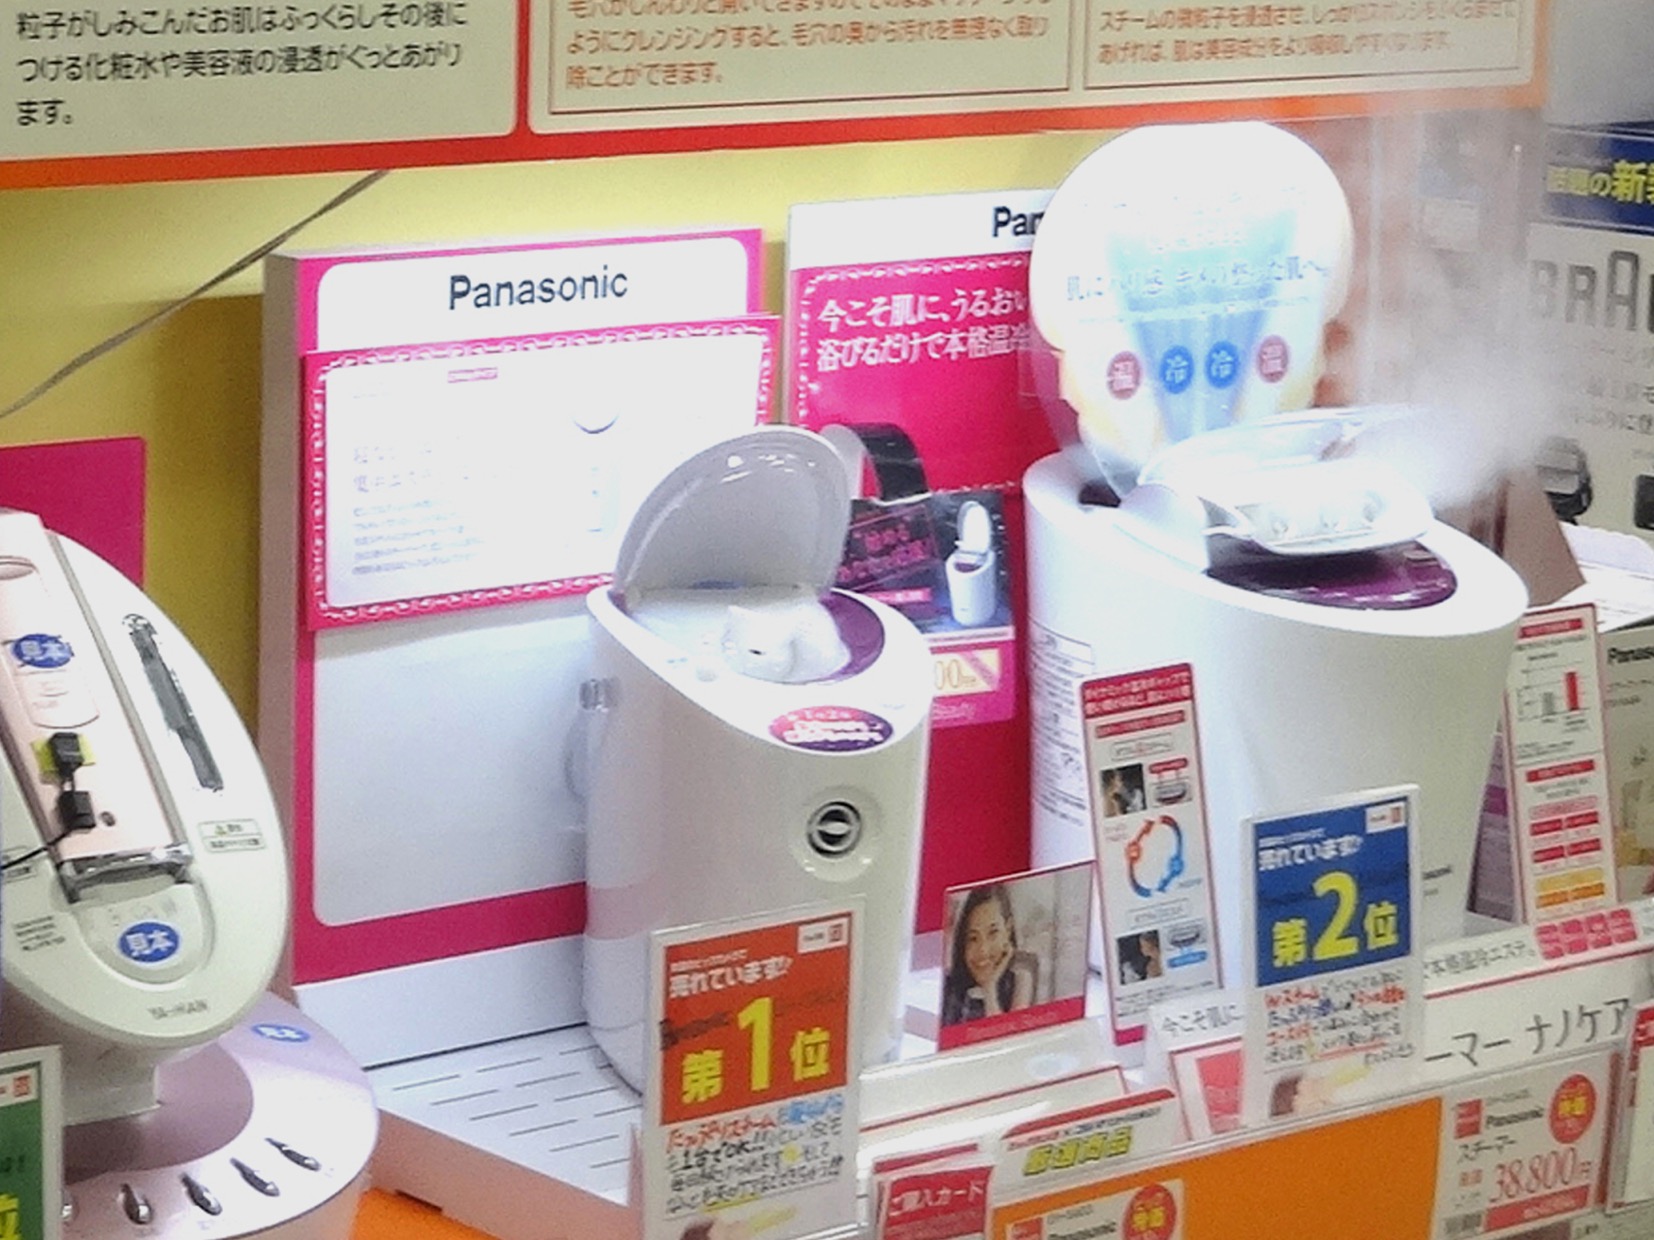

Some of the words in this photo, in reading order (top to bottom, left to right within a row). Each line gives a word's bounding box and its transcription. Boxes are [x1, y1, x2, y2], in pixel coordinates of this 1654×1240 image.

[15, 98, 75, 127] ます。
[448, 264, 629, 311] Panasonic
[124, 929, 175, 959] 見本
[1271, 870, 1399, 968] 第2位
[680, 996, 832, 1104] 第1位
[1525, 998, 1630, 1055] ナノケア
